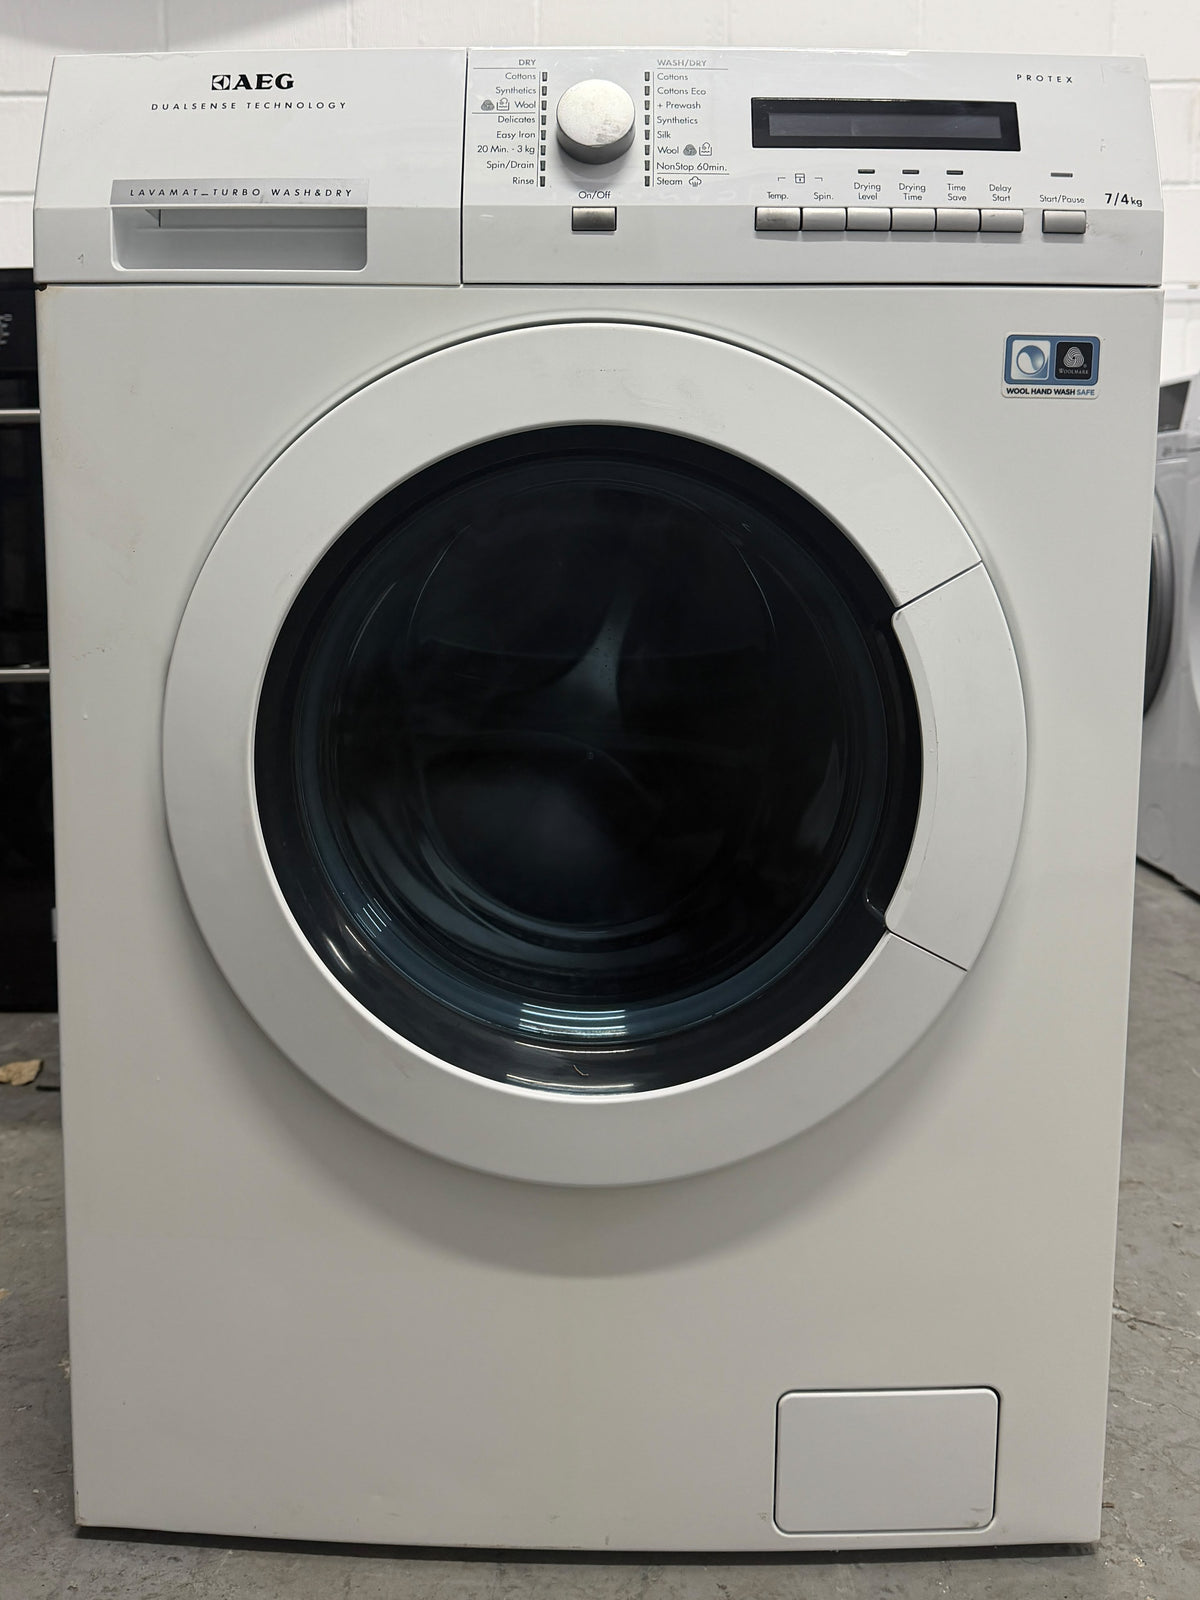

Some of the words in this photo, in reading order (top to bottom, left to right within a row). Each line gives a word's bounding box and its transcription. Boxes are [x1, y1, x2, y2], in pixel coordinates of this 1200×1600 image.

[657, 58, 707, 68] WASH/DRY
[232, 73, 295, 90] AEG
[505, 72, 536, 81] Cottons
[657, 72, 688, 82] Cottons
[1016, 74, 1073, 83] PROTEX
[495, 86, 537, 95] Synthetics
[657, 86, 688, 96] Cottons
[691, 87, 707, 97] Eco
[151, 102, 237, 111] DUALSENSE
[246, 101, 348, 110] TECHNOLOGY
[514, 100, 536, 110] Wool
[666, 101, 701, 110] Prewash
[497, 115, 536, 125] Delicates
[656, 115, 698, 125] Synthetics
[496, 130, 516, 140] Easy
[519, 130, 536, 139] Iron
[656, 130, 671, 139] Silk
[477, 145, 488, 154] 20
[491, 144, 509, 154] Min.
[517, 144, 523, 154] 3
[524, 144, 535, 156] kg
[657, 145, 680, 155] Wool
[486, 160, 535, 171] Spin/Drain
[656, 162, 694, 172] NonStop
[696, 161, 728, 172] 60min.
[512, 176, 535, 186] Rinse
[656, 177, 683, 186] Steam
[853, 182, 881, 192] Drying
[898, 183, 926, 193] Drying
[947, 183, 966, 192] Time
[988, 184, 1012, 193] Delay
[270, 188, 353, 198] WASH&DRY
[578, 190, 611, 200] On/Off
[766, 192, 789, 201] Temp.
[813, 192, 834, 201] Spin.
[858, 191, 878, 201] Level
[903, 192, 923, 201] Time
[947, 193, 967, 202] Save
[992, 193, 1011, 203] Start
[1039, 194, 1085, 205] Start/Pause
